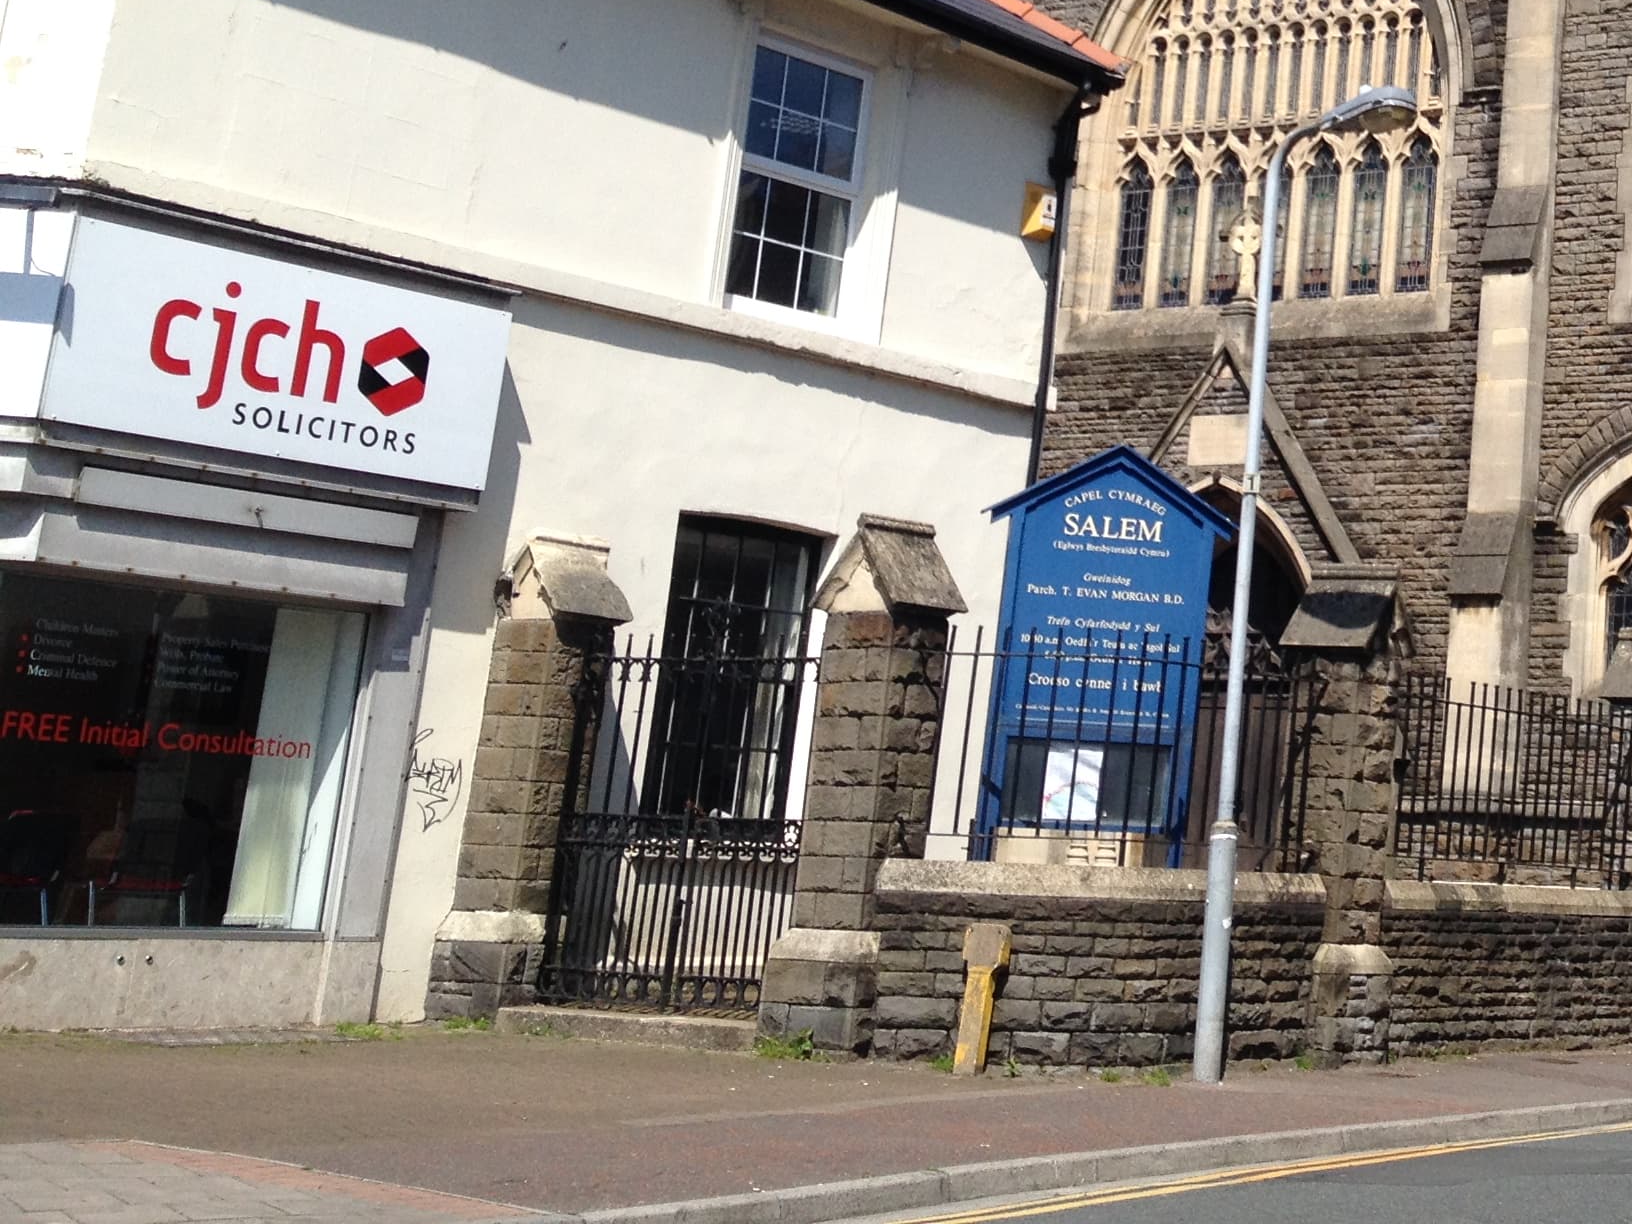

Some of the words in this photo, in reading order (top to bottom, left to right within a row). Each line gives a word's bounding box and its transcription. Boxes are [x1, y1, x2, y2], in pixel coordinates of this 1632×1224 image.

[150, 281, 346, 409] cjch
[232, 402, 416, 454] SOLICITORS
[1064, 490, 1103, 508] CAPEL
[1108, 490, 1168, 516] CYMRAEG
[1063, 513, 1163, 542] SALEM
[1083, 573, 1132, 587] Gweinidog
[1027, 584, 1057, 596] Parch.
[1076, 587, 1108, 599] EVAN
[1111, 591, 1160, 604] MORGAN
[1163, 595, 1185, 605] B.D.
[1144, 623, 1161, 633] Sul
[33, 634, 73, 649] Divorce
[30, 648, 75, 664] Criminal
[27, 663, 64, 678] Mental
[66, 666, 99, 681] Health
[154, 678, 211, 693] Commercial
[213, 680, 233, 694] Law
[1122, 678, 1128, 692] i
[0, 710, 73, 743] FREE
[80, 716, 150, 748] Initial
[157, 722, 312, 760] Consultation
